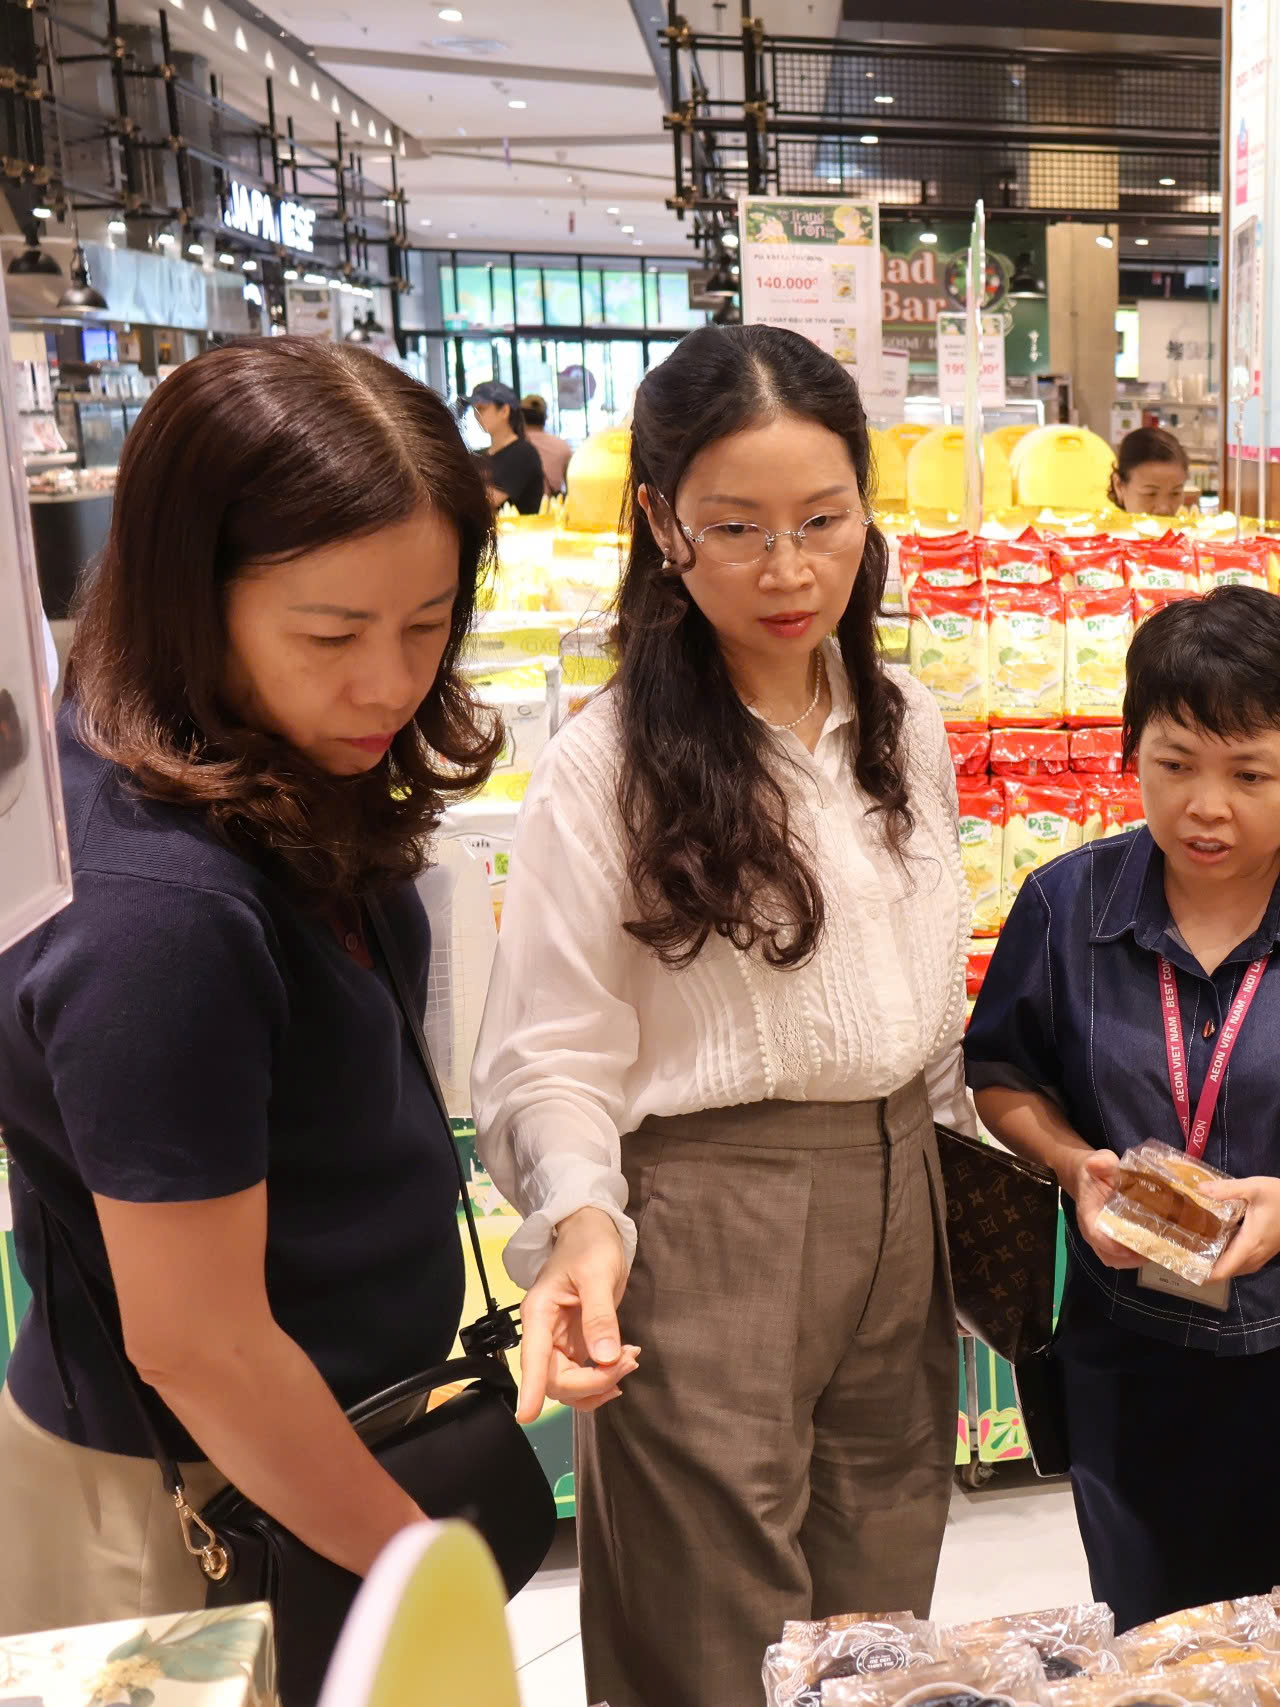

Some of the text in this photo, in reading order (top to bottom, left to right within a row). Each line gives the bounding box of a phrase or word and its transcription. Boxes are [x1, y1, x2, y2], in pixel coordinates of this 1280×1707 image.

[881, 290, 947, 322] Bar
[1164, 983, 1175, 1007] BEST
[1168, 1016, 1179, 1042] NAM
[1209, 1051, 1226, 1082] AEON
[1230, 999, 1246, 1024] NAM
[1171, 1046, 1180, 1069] VIET
[1173, 1071, 1185, 1102] AEON
